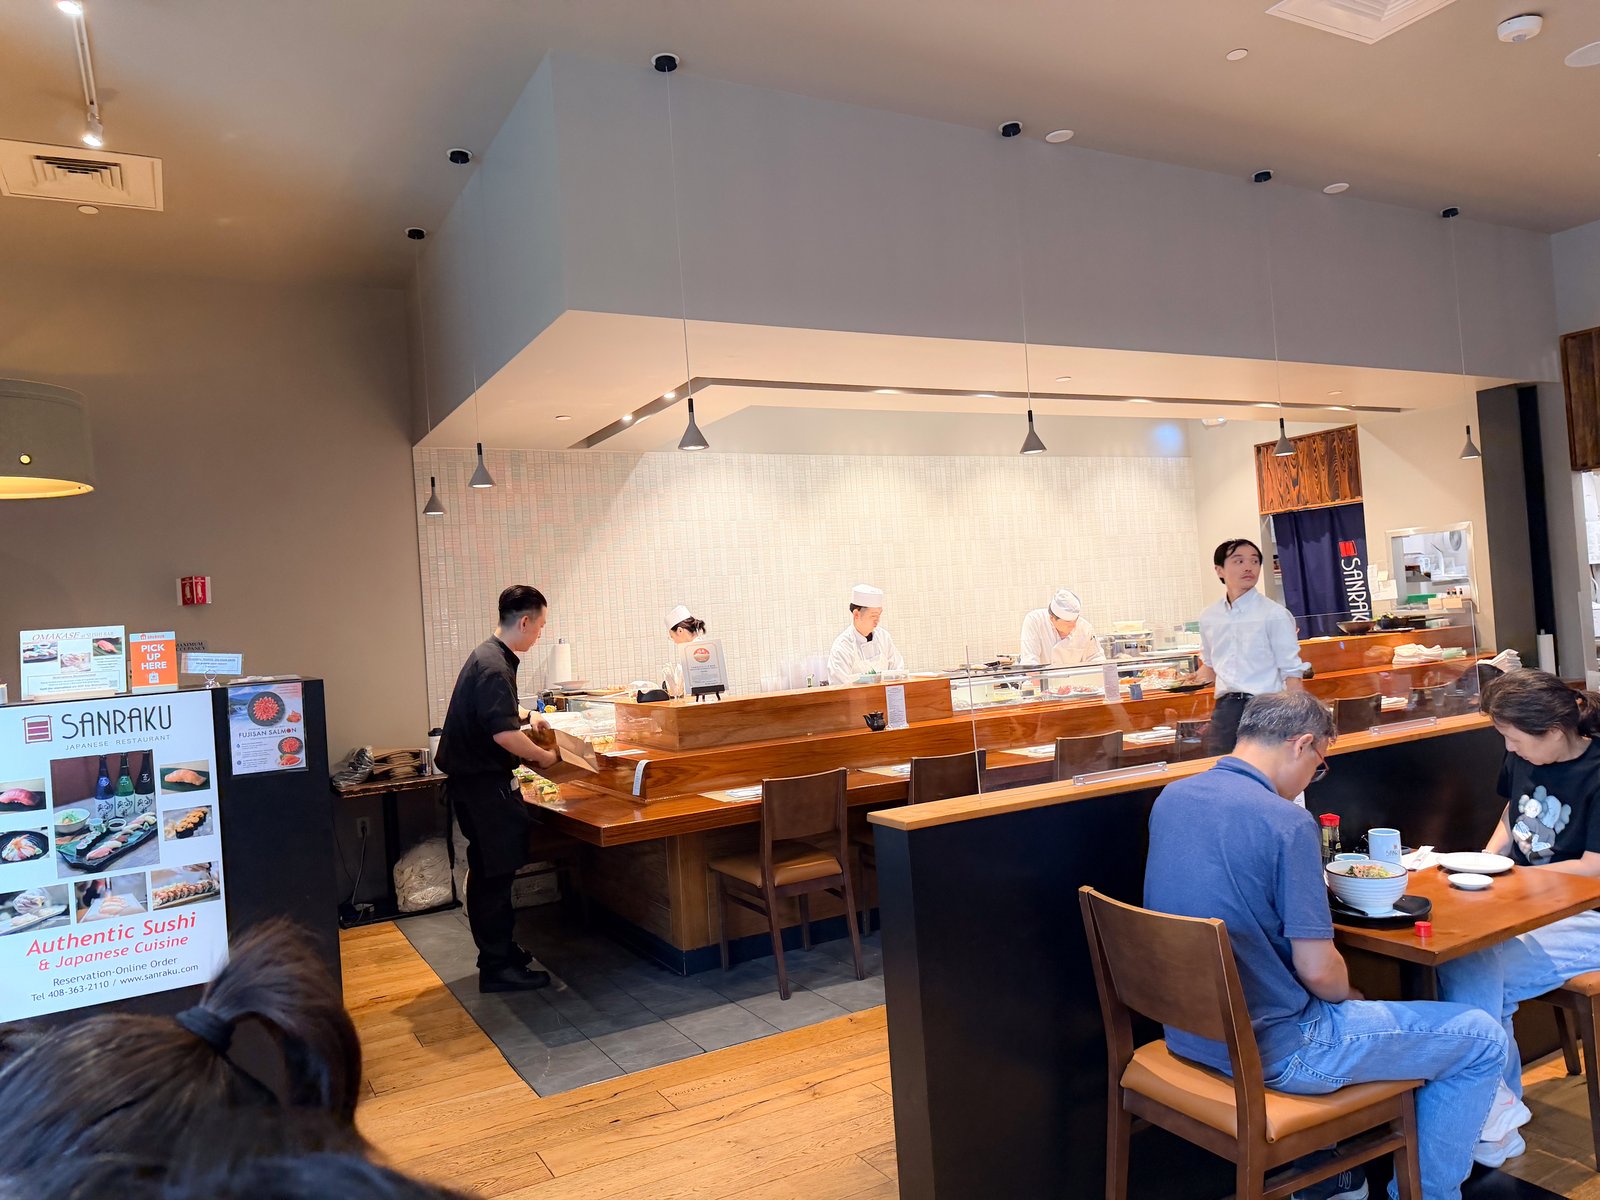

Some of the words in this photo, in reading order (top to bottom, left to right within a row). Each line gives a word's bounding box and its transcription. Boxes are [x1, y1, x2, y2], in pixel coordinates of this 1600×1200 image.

[1341, 557, 1370, 622] SANRAK
[32, 631, 80, 641] OMAKASE
[141, 643, 165, 653] PICK
[146, 652, 161, 661] UP
[141, 661, 167, 670] HERE
[61, 704, 172, 740] SANRAKU
[238, 729, 267, 738] FUJISAN
[268, 727, 297, 736] SALMON
[65, 740, 109, 751] JAPANESE
[115, 734, 171, 745] RESTAURANT
[25, 924, 135, 957] Authentic
[143, 911, 196, 936] Sushi
[38, 958, 50, 971] &
[55, 946, 129, 968] Japanese
[134, 936, 189, 954] Cuisine
[31, 993, 45, 1002] Tel
[47, 980, 110, 998] 408-363-2110
[119, 964, 199, 985] www.sanraku.com
[53, 962, 147, 987] Reservation-Online
[150, 957, 178, 968] Order
